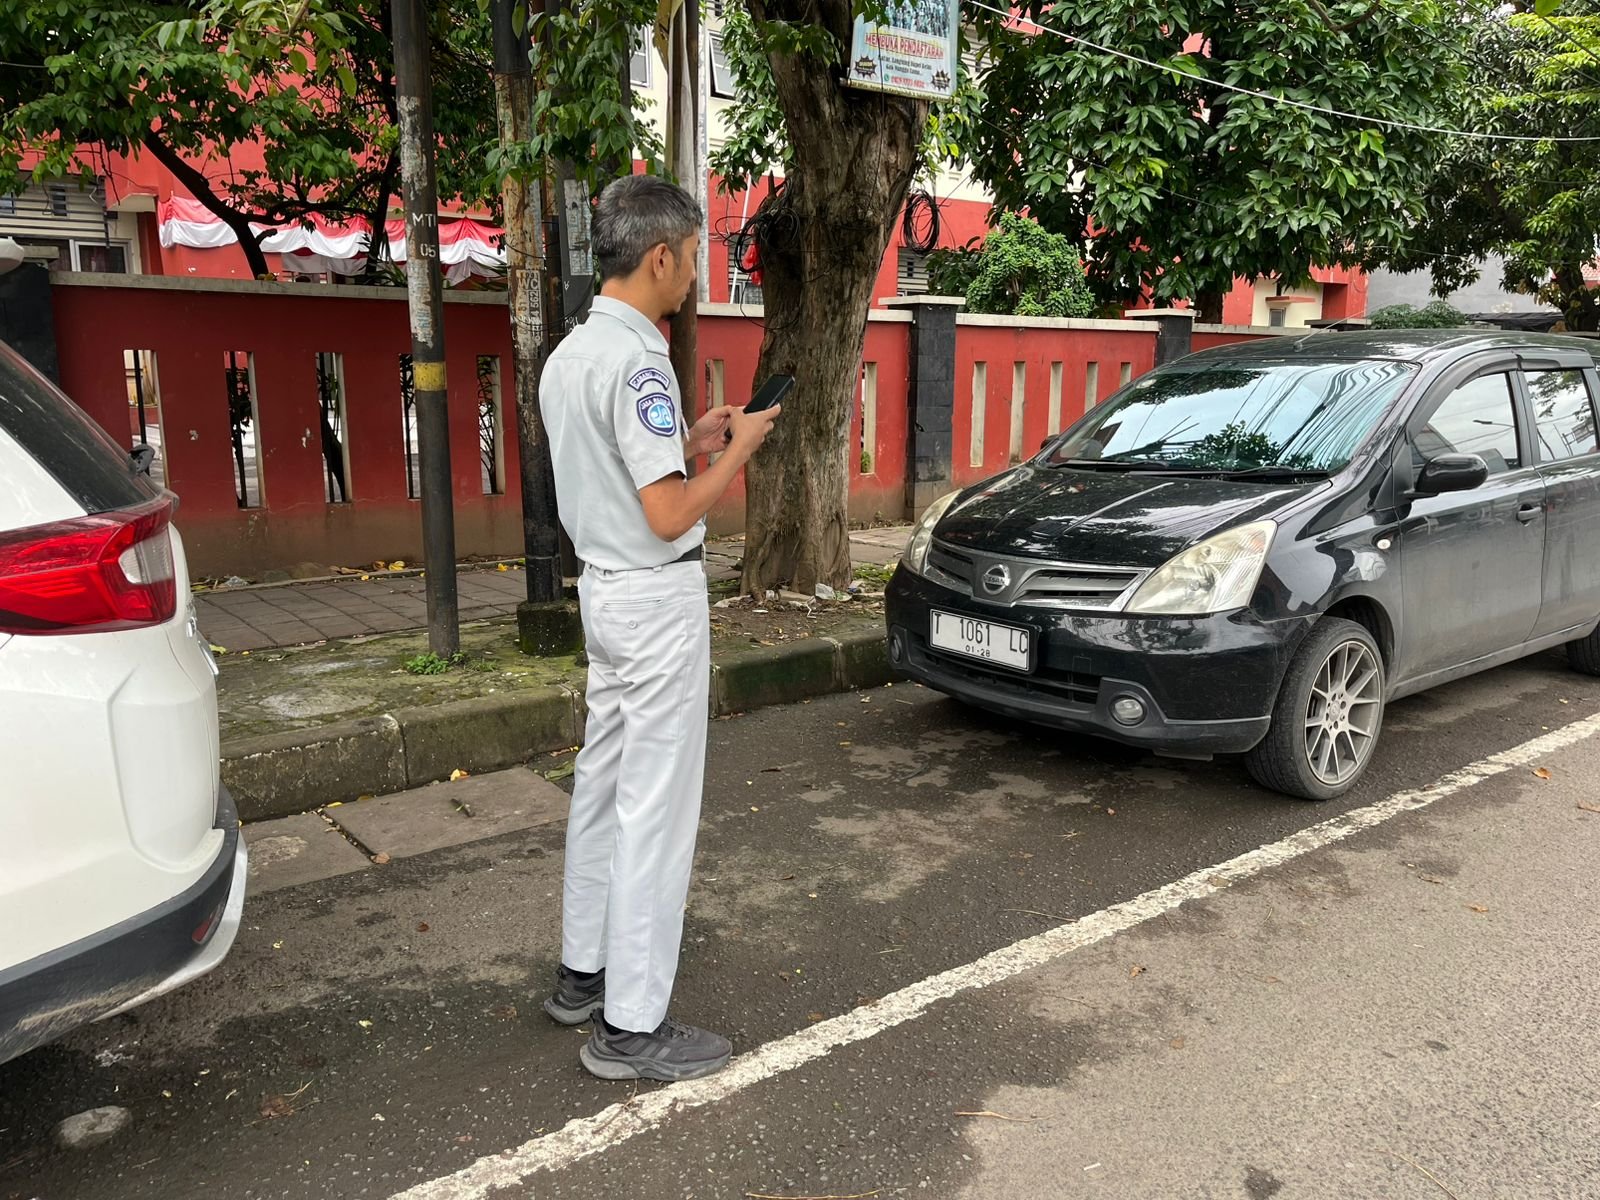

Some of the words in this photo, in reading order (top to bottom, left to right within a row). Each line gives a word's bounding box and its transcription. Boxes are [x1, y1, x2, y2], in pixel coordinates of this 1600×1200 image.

[900, 38, 944, 58] PENDAFTARAN
[412, 212, 436, 227] MTI
[420, 243, 436, 257] 05
[518, 278, 538, 290] WC
[640, 399, 653, 410] JASA
[935, 613, 942, 635] T
[960, 618, 991, 647] 1061
[1009, 629, 1028, 654] LC
